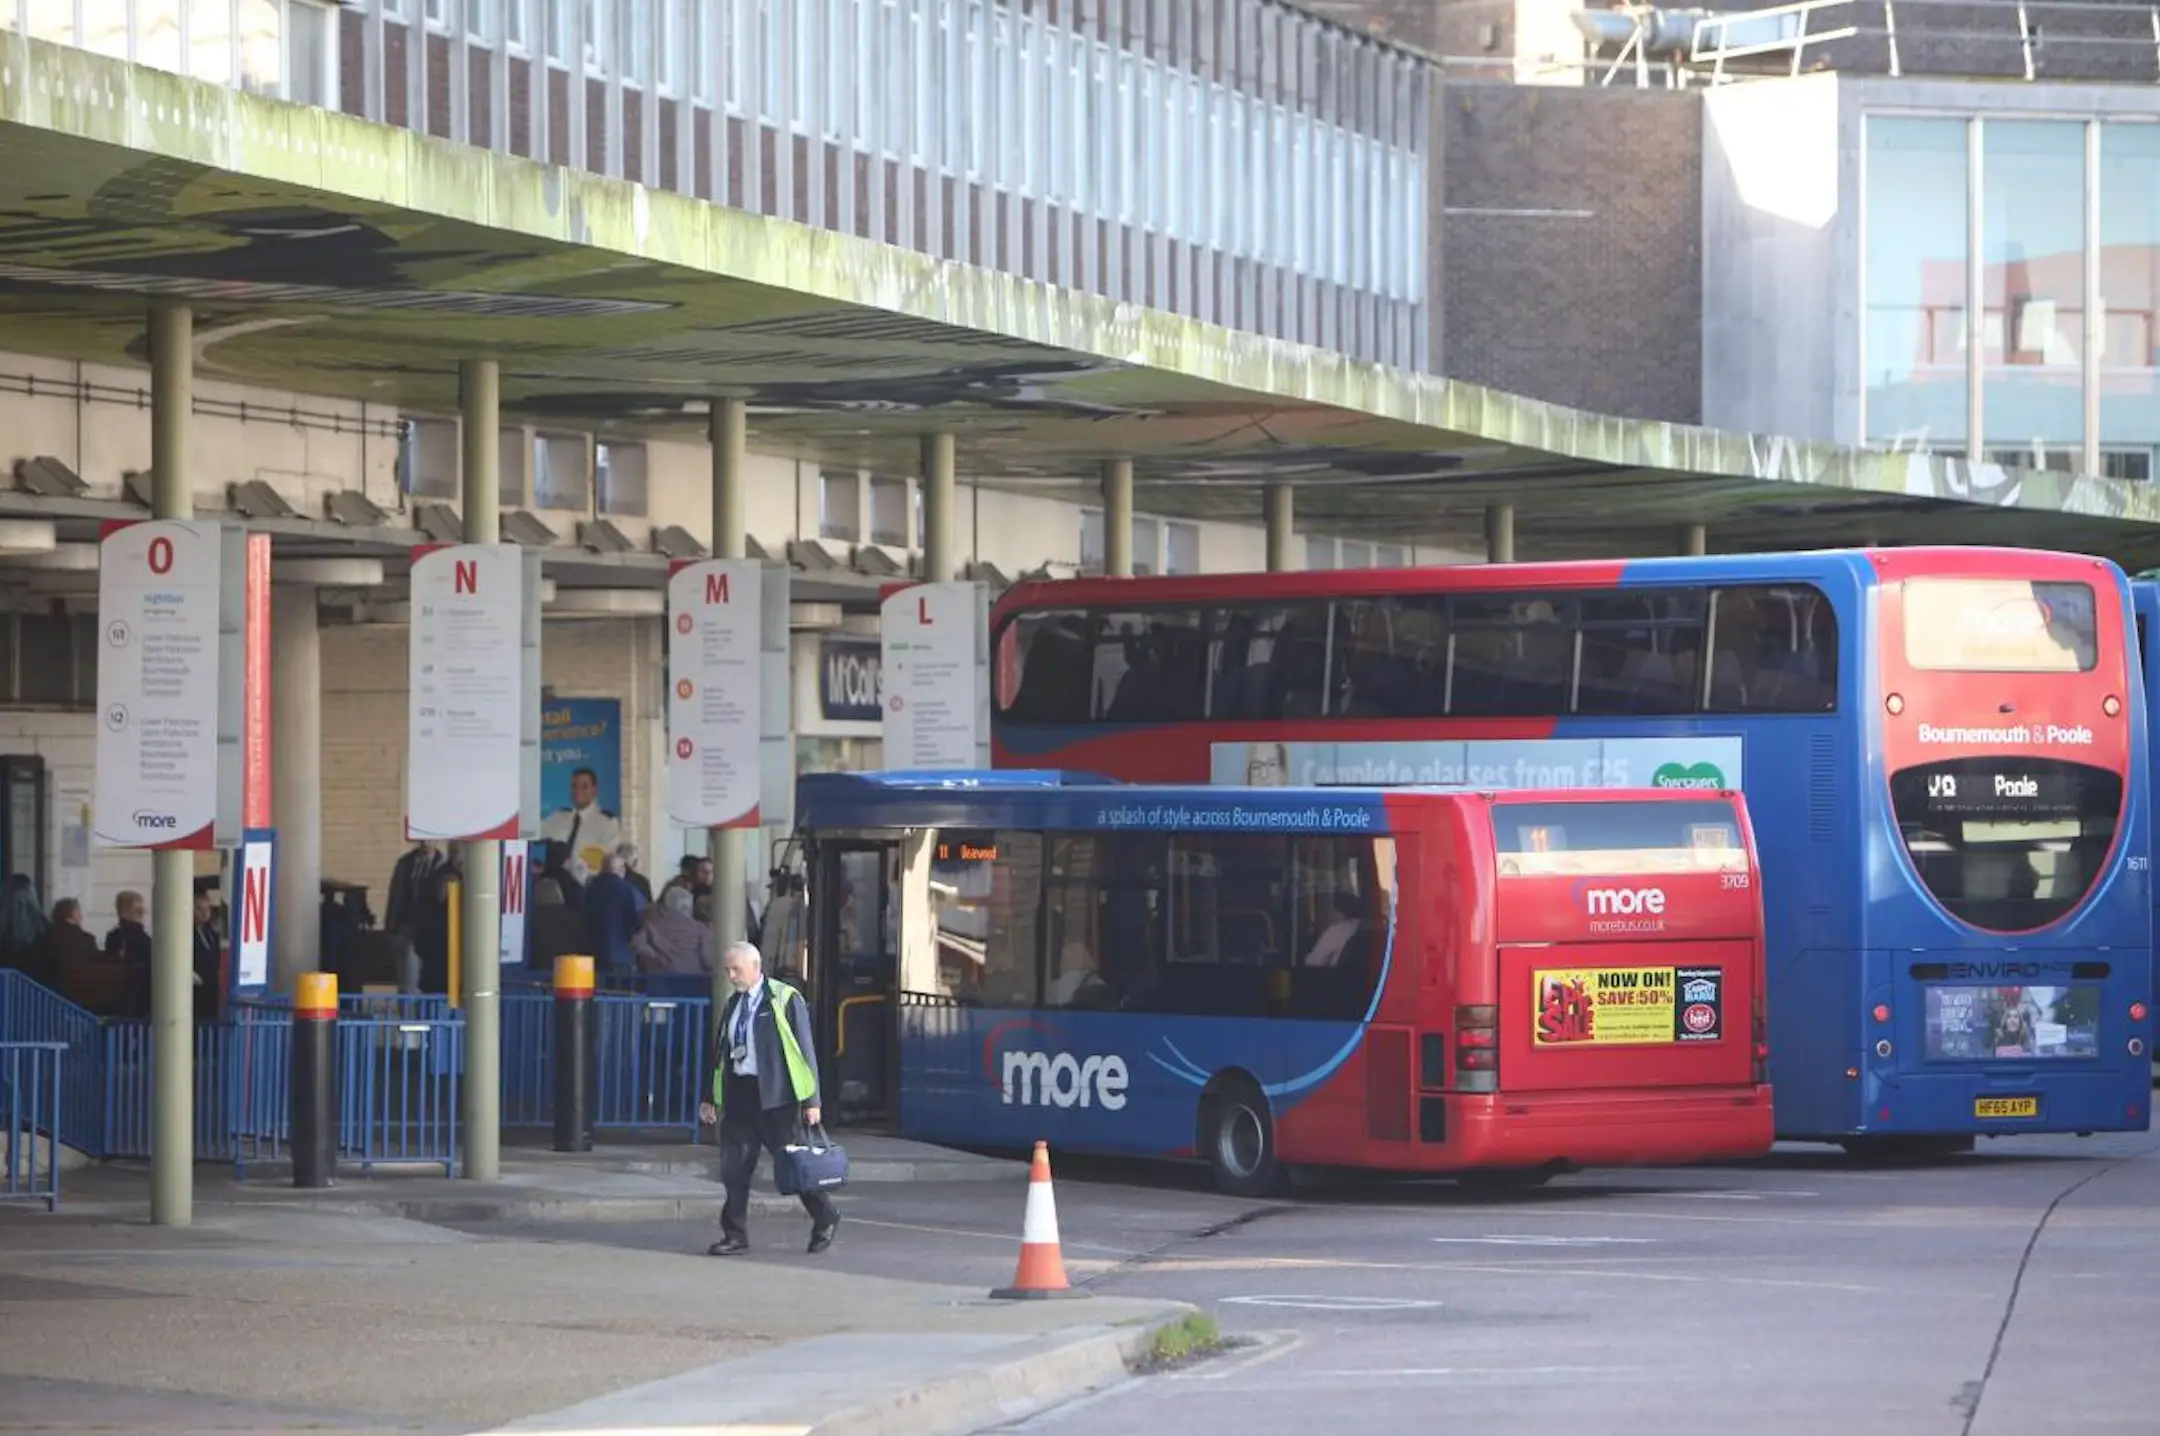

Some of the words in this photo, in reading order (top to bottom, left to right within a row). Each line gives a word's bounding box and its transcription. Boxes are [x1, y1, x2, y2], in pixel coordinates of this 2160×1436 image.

[148, 536, 174, 575] O
[455, 560, 477, 594] N
[705, 573, 729, 604] M
[918, 596, 933, 625] L
[1918, 723, 2029, 743] Bournemouth
[2032, 725, 2044, 744] &
[2047, 725, 2092, 744] Poole
[1515, 757, 1574, 787] from
[1994, 774, 2038, 797] Poole
[137, 815, 177, 828] more
[1098, 810, 1106, 823] a
[1109, 805, 1149, 828] splash
[1150, 805, 1161, 824] of
[1163, 805, 1190, 828] style
[1192, 811, 1230, 825] across
[1233, 806, 1318, 827] Bournemouth
[1321, 808, 1333, 827] &
[1335, 808, 1371, 828] Poole
[2126, 856, 2147, 870] 1611
[502, 855, 523, 914] M
[1720, 874, 1749, 889] 3709
[243, 867, 267, 942] N
[1588, 887, 1666, 915] more
[1590, 919, 1665, 934] morebus.co.uk
[1597, 972, 1638, 988] NOW
[1643, 972, 1671, 988] ON!
[1597, 990, 1635, 1006] SAVE
[1638, 989, 1673, 1005] 50%
[1002, 1050, 1130, 1112] more
